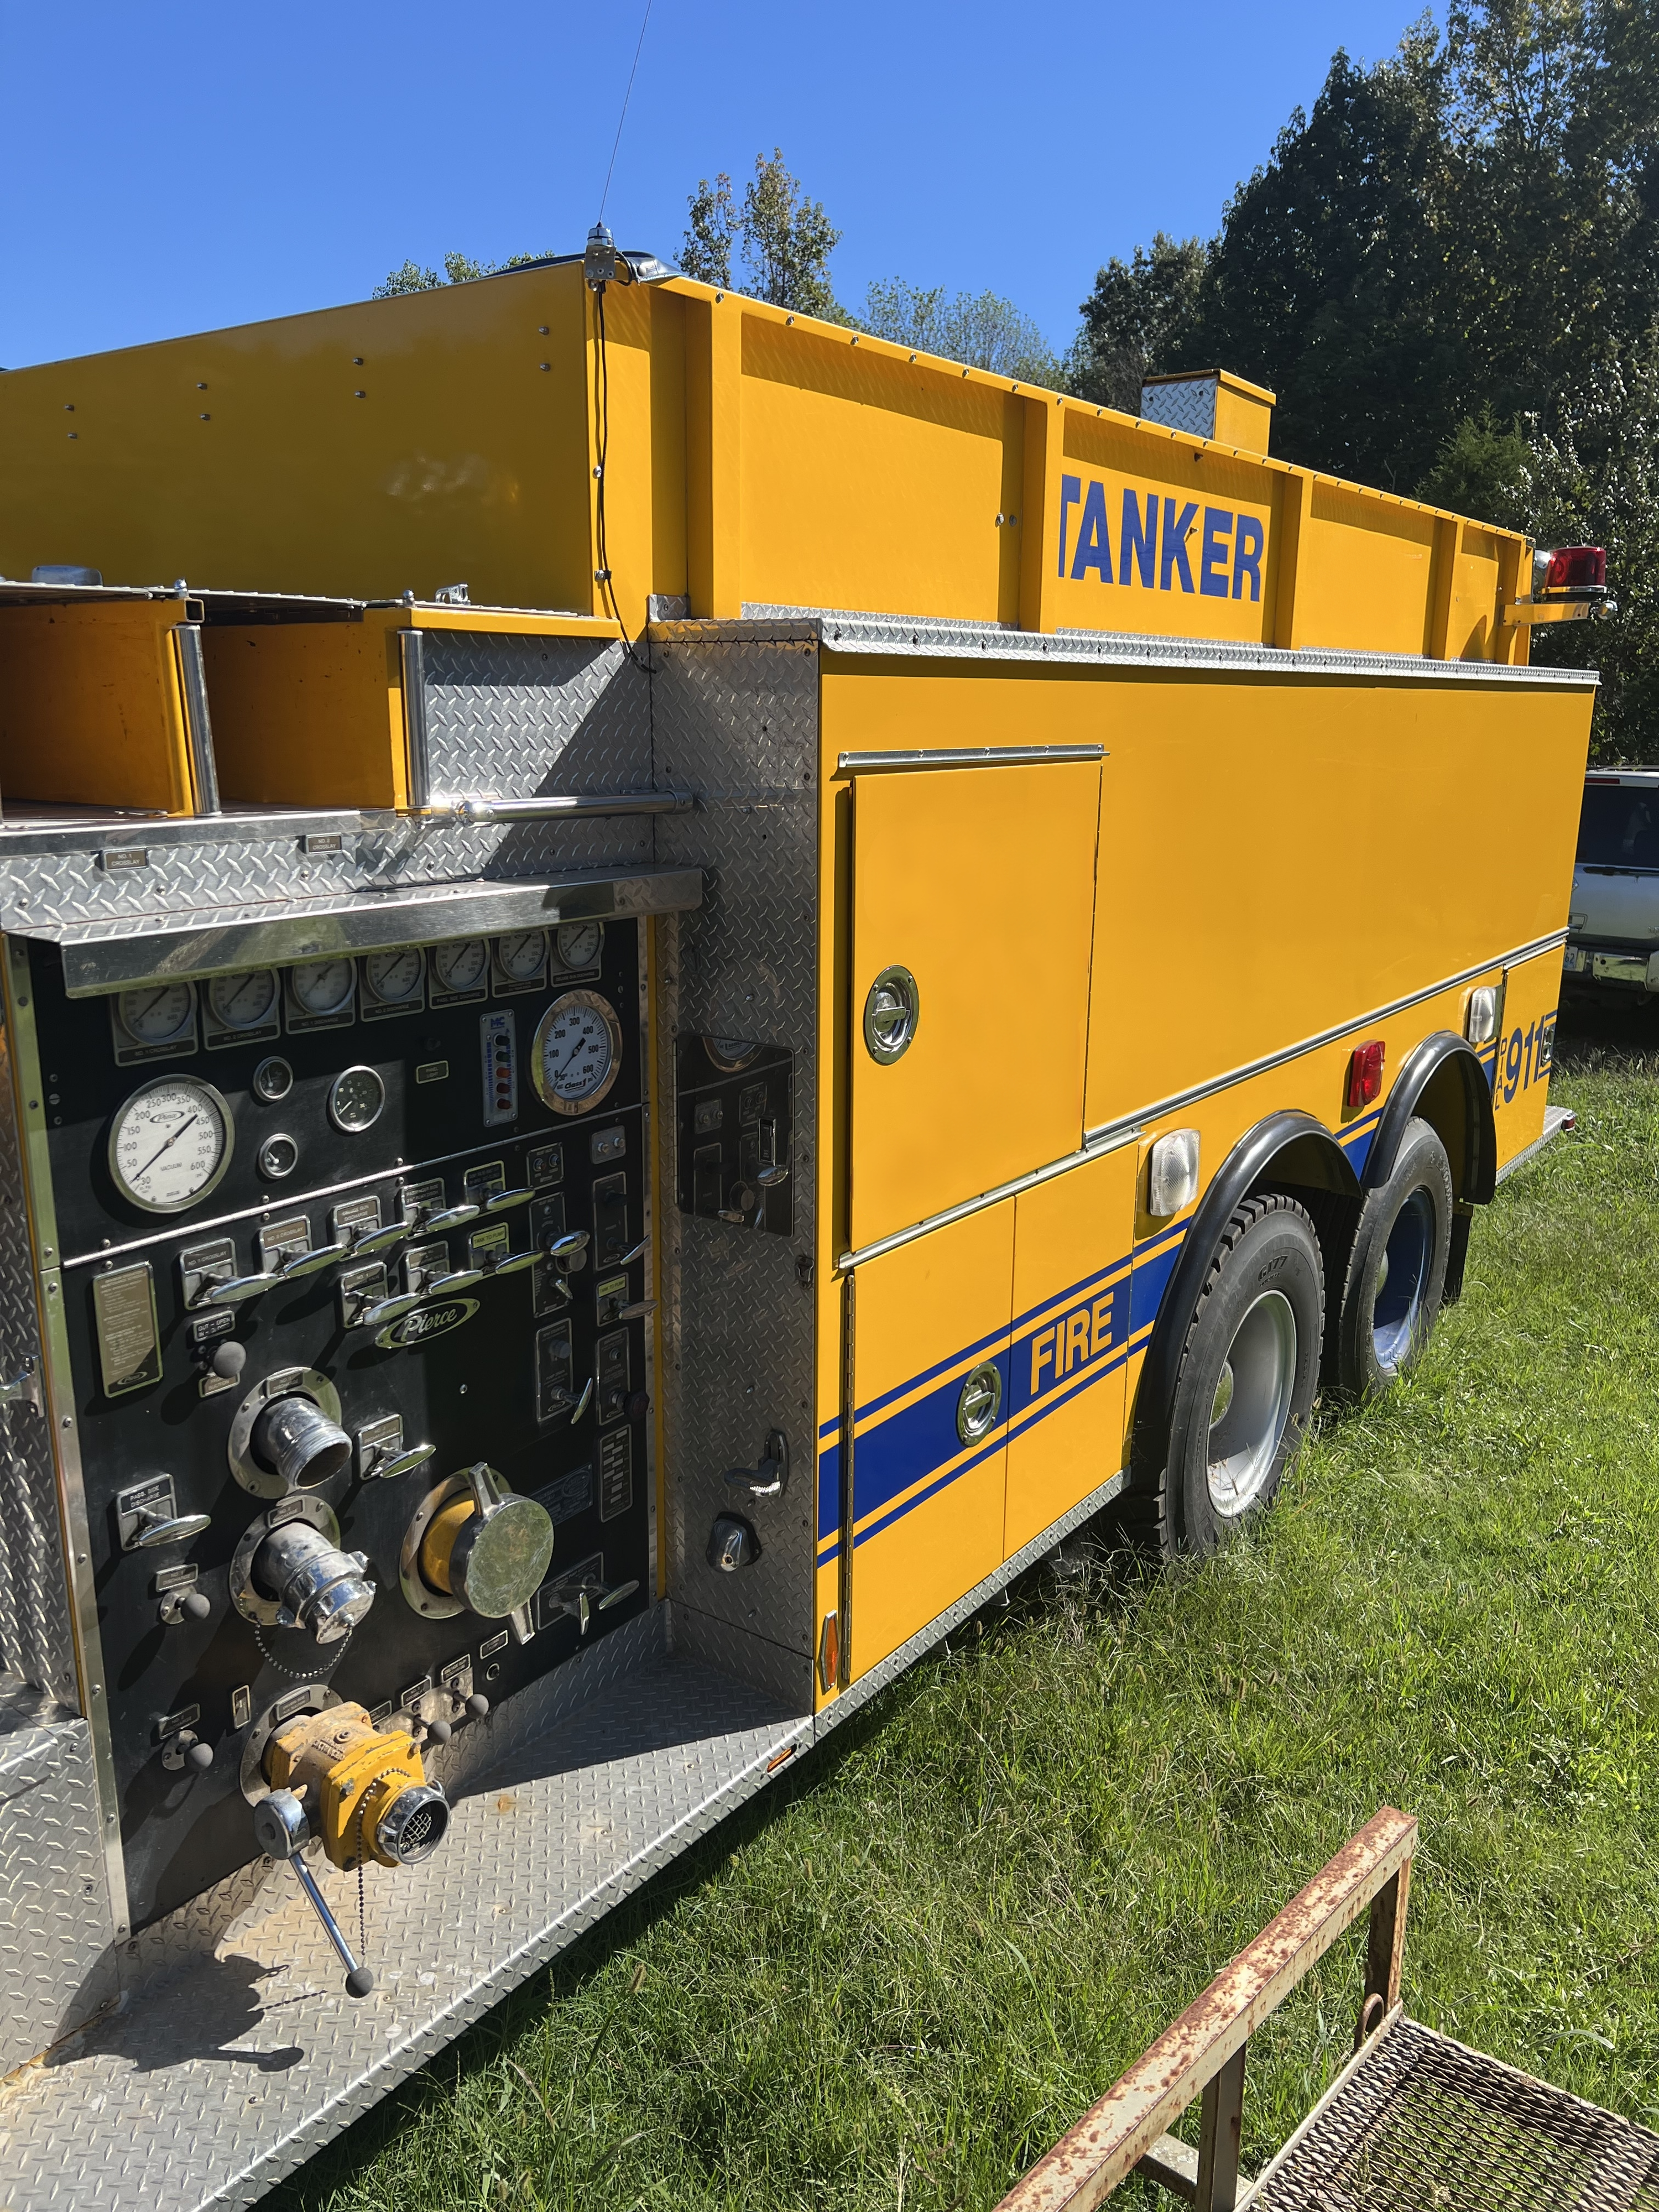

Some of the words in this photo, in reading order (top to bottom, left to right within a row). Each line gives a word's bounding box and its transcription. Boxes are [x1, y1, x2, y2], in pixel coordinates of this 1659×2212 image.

[569, 1017, 580, 1026] 300
[555, 1029, 566, 1039] 200
[582, 1025, 593, 1035] 400
[549, 1050, 559, 1058] 100
[588, 1044, 599, 1054] 500
[1504, 1015, 1545, 1103] 911
[582, 1064, 594, 1074] 600
[1495, 1037, 1507, 1110] DIAL
[147, 1098, 161, 1108] 250
[161, 1093, 177, 1103] 300
[176, 1095, 191, 1105] 350
[187, 1104, 202, 1114] 400
[135, 1110, 150, 1120] 200
[196, 1116, 210, 1125] 450
[127, 1125, 140, 1135] 150
[199, 1130, 213, 1140] 500
[123, 1142, 137, 1151] 100
[197, 1145, 211, 1155] 550
[127, 1159, 137, 1168] 50
[160, 1162, 182, 1171] VACUUM
[190, 1160, 206, 1170] 600
[140, 1176, 151, 1185] 30
[344, 1211, 368, 1222] DISCHARGE
[279, 1227, 304, 1238] CROSSLAY
[201, 1250, 227, 1262] CROSSLAY
[1258, 1254, 1288, 1282] G177
[198, 1323, 209, 1332] OUT
[216, 1317, 230, 1326] OPEN
[400, 1308, 457, 1342] Pierce
[1031, 1291, 1114, 1396] FIRE
[208, 1380, 229, 1391] SUCTION
[147, 1485, 160, 1494] SIDE
[131, 1491, 160, 1508] DISCHARGE
[163, 1573, 191, 1585] DISCHARGE
